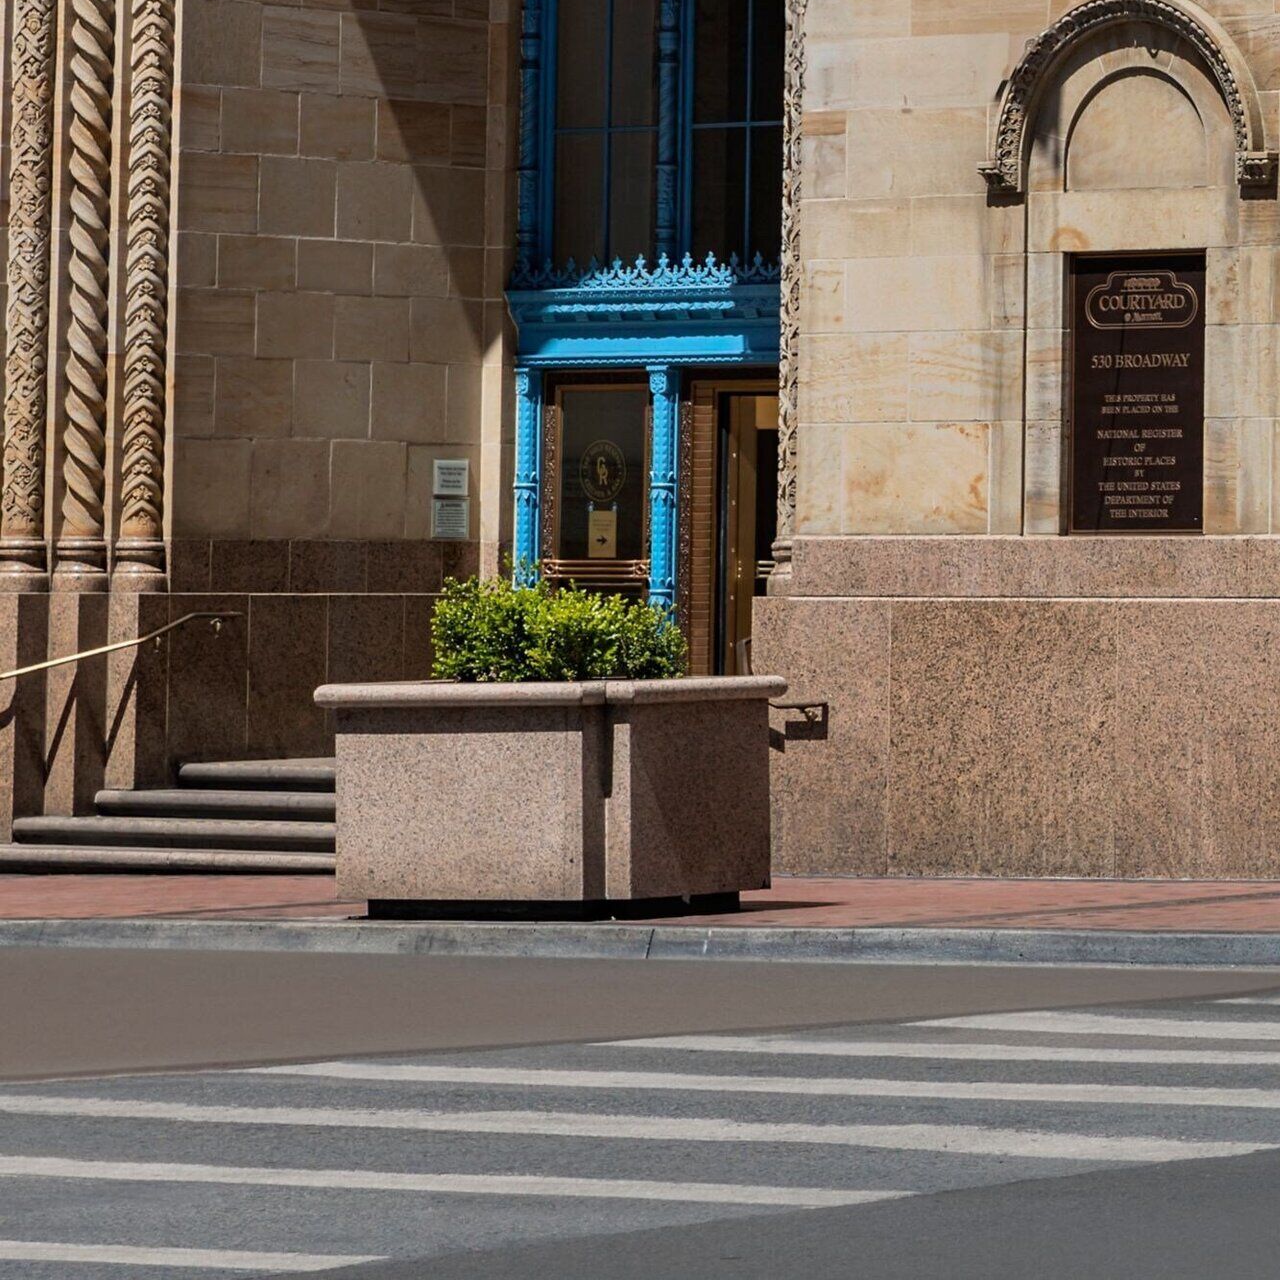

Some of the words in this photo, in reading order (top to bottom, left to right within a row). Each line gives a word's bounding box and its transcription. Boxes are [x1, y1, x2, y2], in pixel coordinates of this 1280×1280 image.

[1099, 293, 1186, 311] COURTYARD
[1091, 354, 1112, 369] 530
[1115, 353, 1191, 368] BROADWAY
[1123, 393, 1160, 403] PROPERTY
[1161, 393, 1176, 402] HAS
[1101, 405, 1121, 415] BEEN
[1122, 405, 1151, 414] PLACED
[1152, 404, 1163, 414] ON
[1164, 404, 1180, 414] THE
[1097, 429, 1140, 439] NATIONAL
[1141, 428, 1184, 439] REGISTER
[1133, 442, 1146, 453] OF
[1103, 456, 1143, 467] HISTORIC
[1144, 456, 1177, 466] PLACES
[1133, 469, 1145, 478] BY
[1098, 481, 1115, 491] THE
[1116, 481, 1149, 491] UNITED
[1150, 481, 1181, 491] STATES
[1104, 495, 1161, 505] DEPARTMENT
[1162, 495, 1175, 505] OF
[1109, 508, 1127, 518] THE
[1128, 508, 1169, 518] INTERIOR
